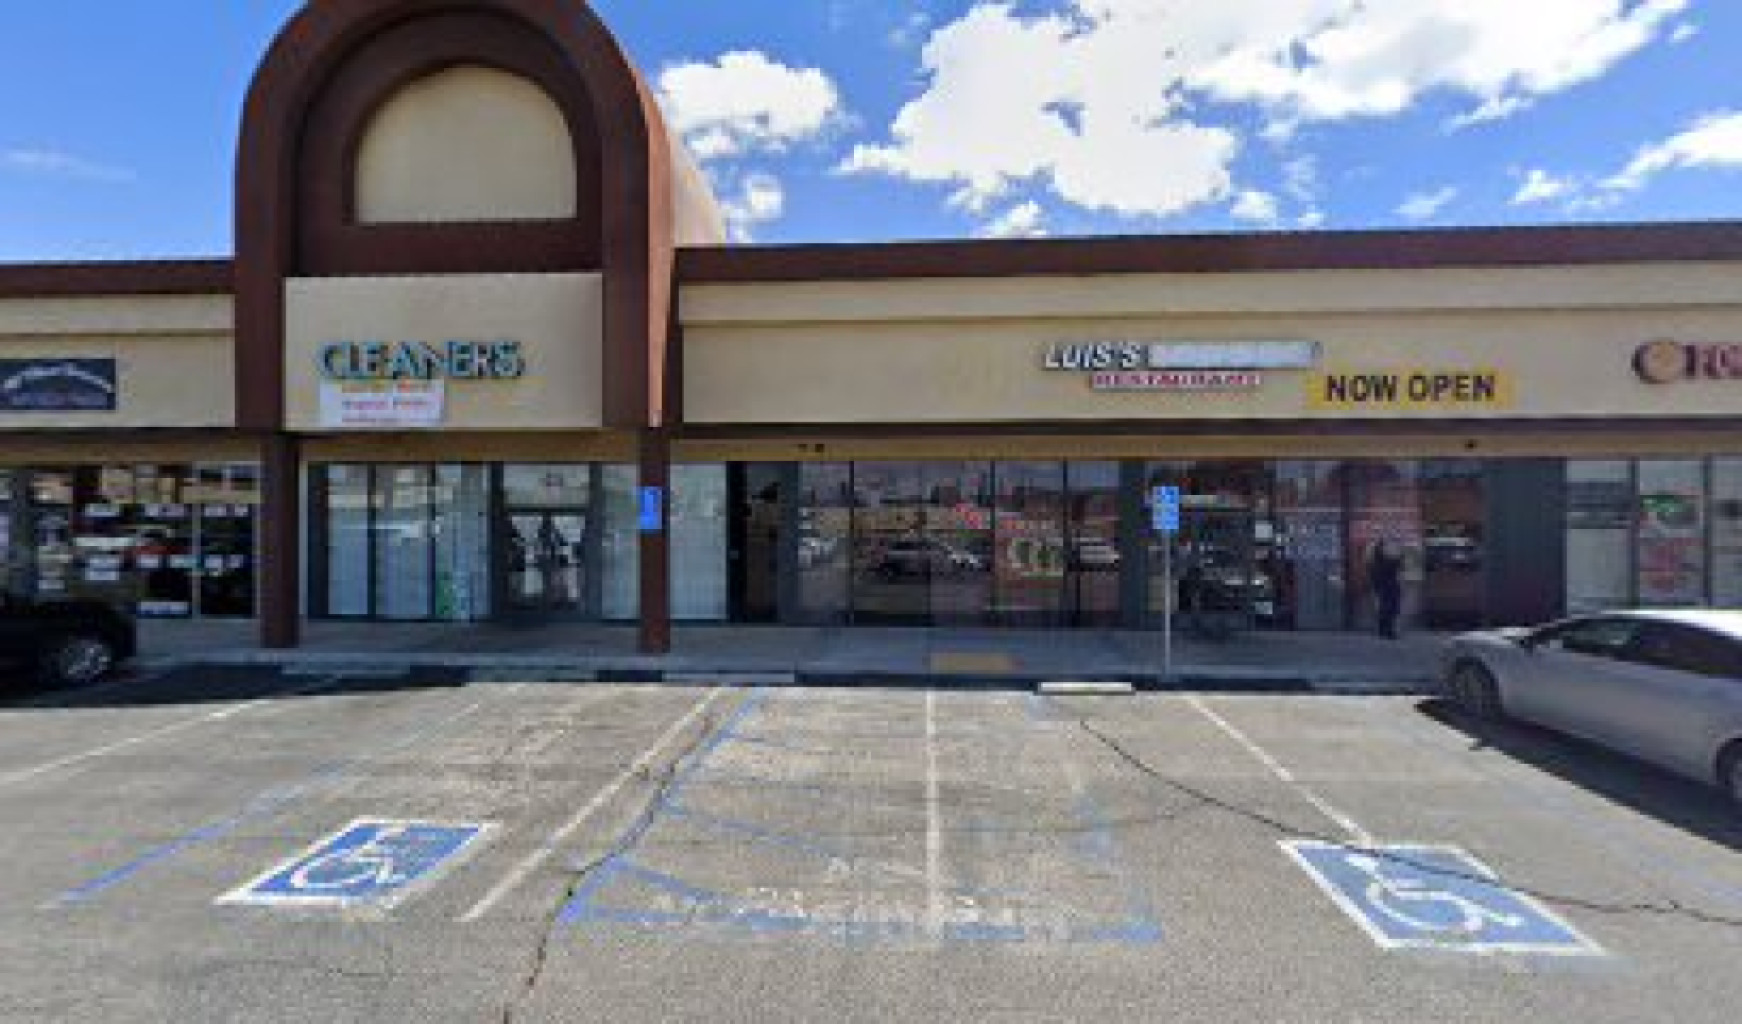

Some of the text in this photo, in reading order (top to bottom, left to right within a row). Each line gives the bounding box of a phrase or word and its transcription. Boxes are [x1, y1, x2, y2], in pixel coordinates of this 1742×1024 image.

[318, 341, 524, 380] CLEANERS
[1325, 374, 1497, 402] NOW OPEN
